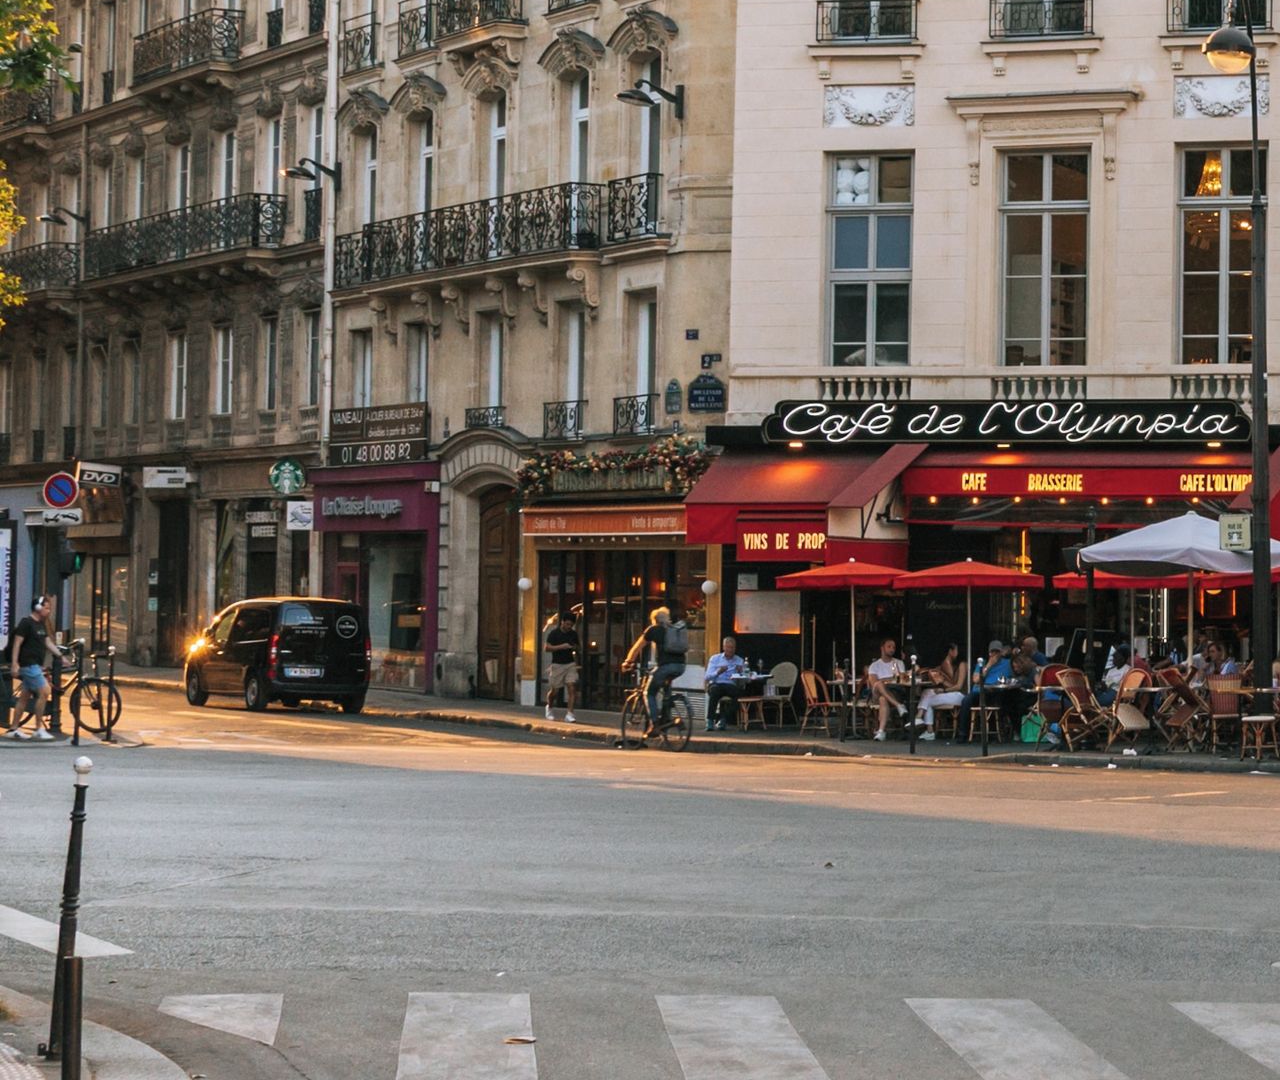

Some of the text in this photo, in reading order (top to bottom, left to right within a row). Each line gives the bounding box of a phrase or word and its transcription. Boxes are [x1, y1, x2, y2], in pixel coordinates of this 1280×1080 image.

[332, 410, 363, 424] VANEAU
[783, 401, 1238, 443] Café de l'Olympia
[341, 447, 353, 463] 01
[356, 446, 368, 462] 48
[369, 445, 381, 461] 00
[383, 444, 396, 460] 88
[82, 471, 116, 484] DVD
[961, 472, 1083, 492] CAFE BRASSERIE
[1179, 474, 1206, 492] CAFE
[743, 532, 827, 550] VINS DE PROP
